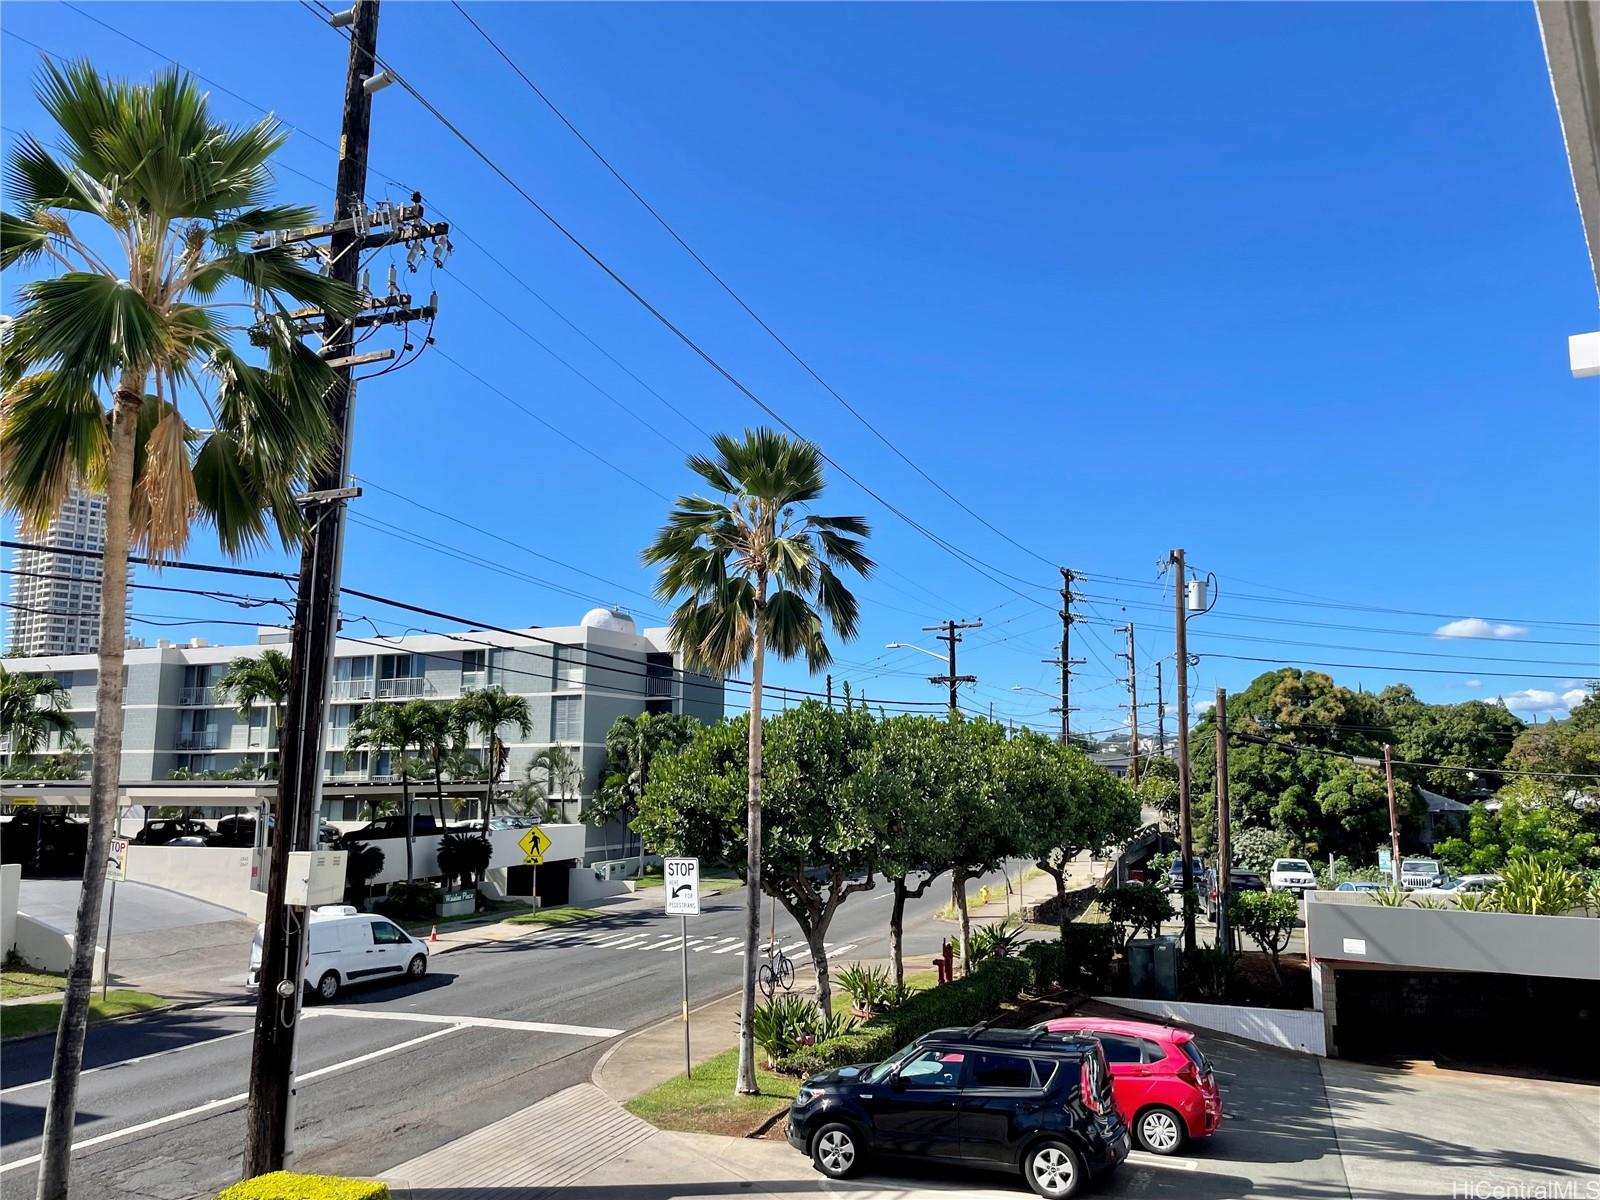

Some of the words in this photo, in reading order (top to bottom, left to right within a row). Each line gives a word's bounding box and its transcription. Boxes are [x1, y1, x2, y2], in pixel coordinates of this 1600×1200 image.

[111, 842, 126, 853] TOP
[668, 862, 695, 876] STOP
[668, 901, 695, 909] PEDESTRIANS
